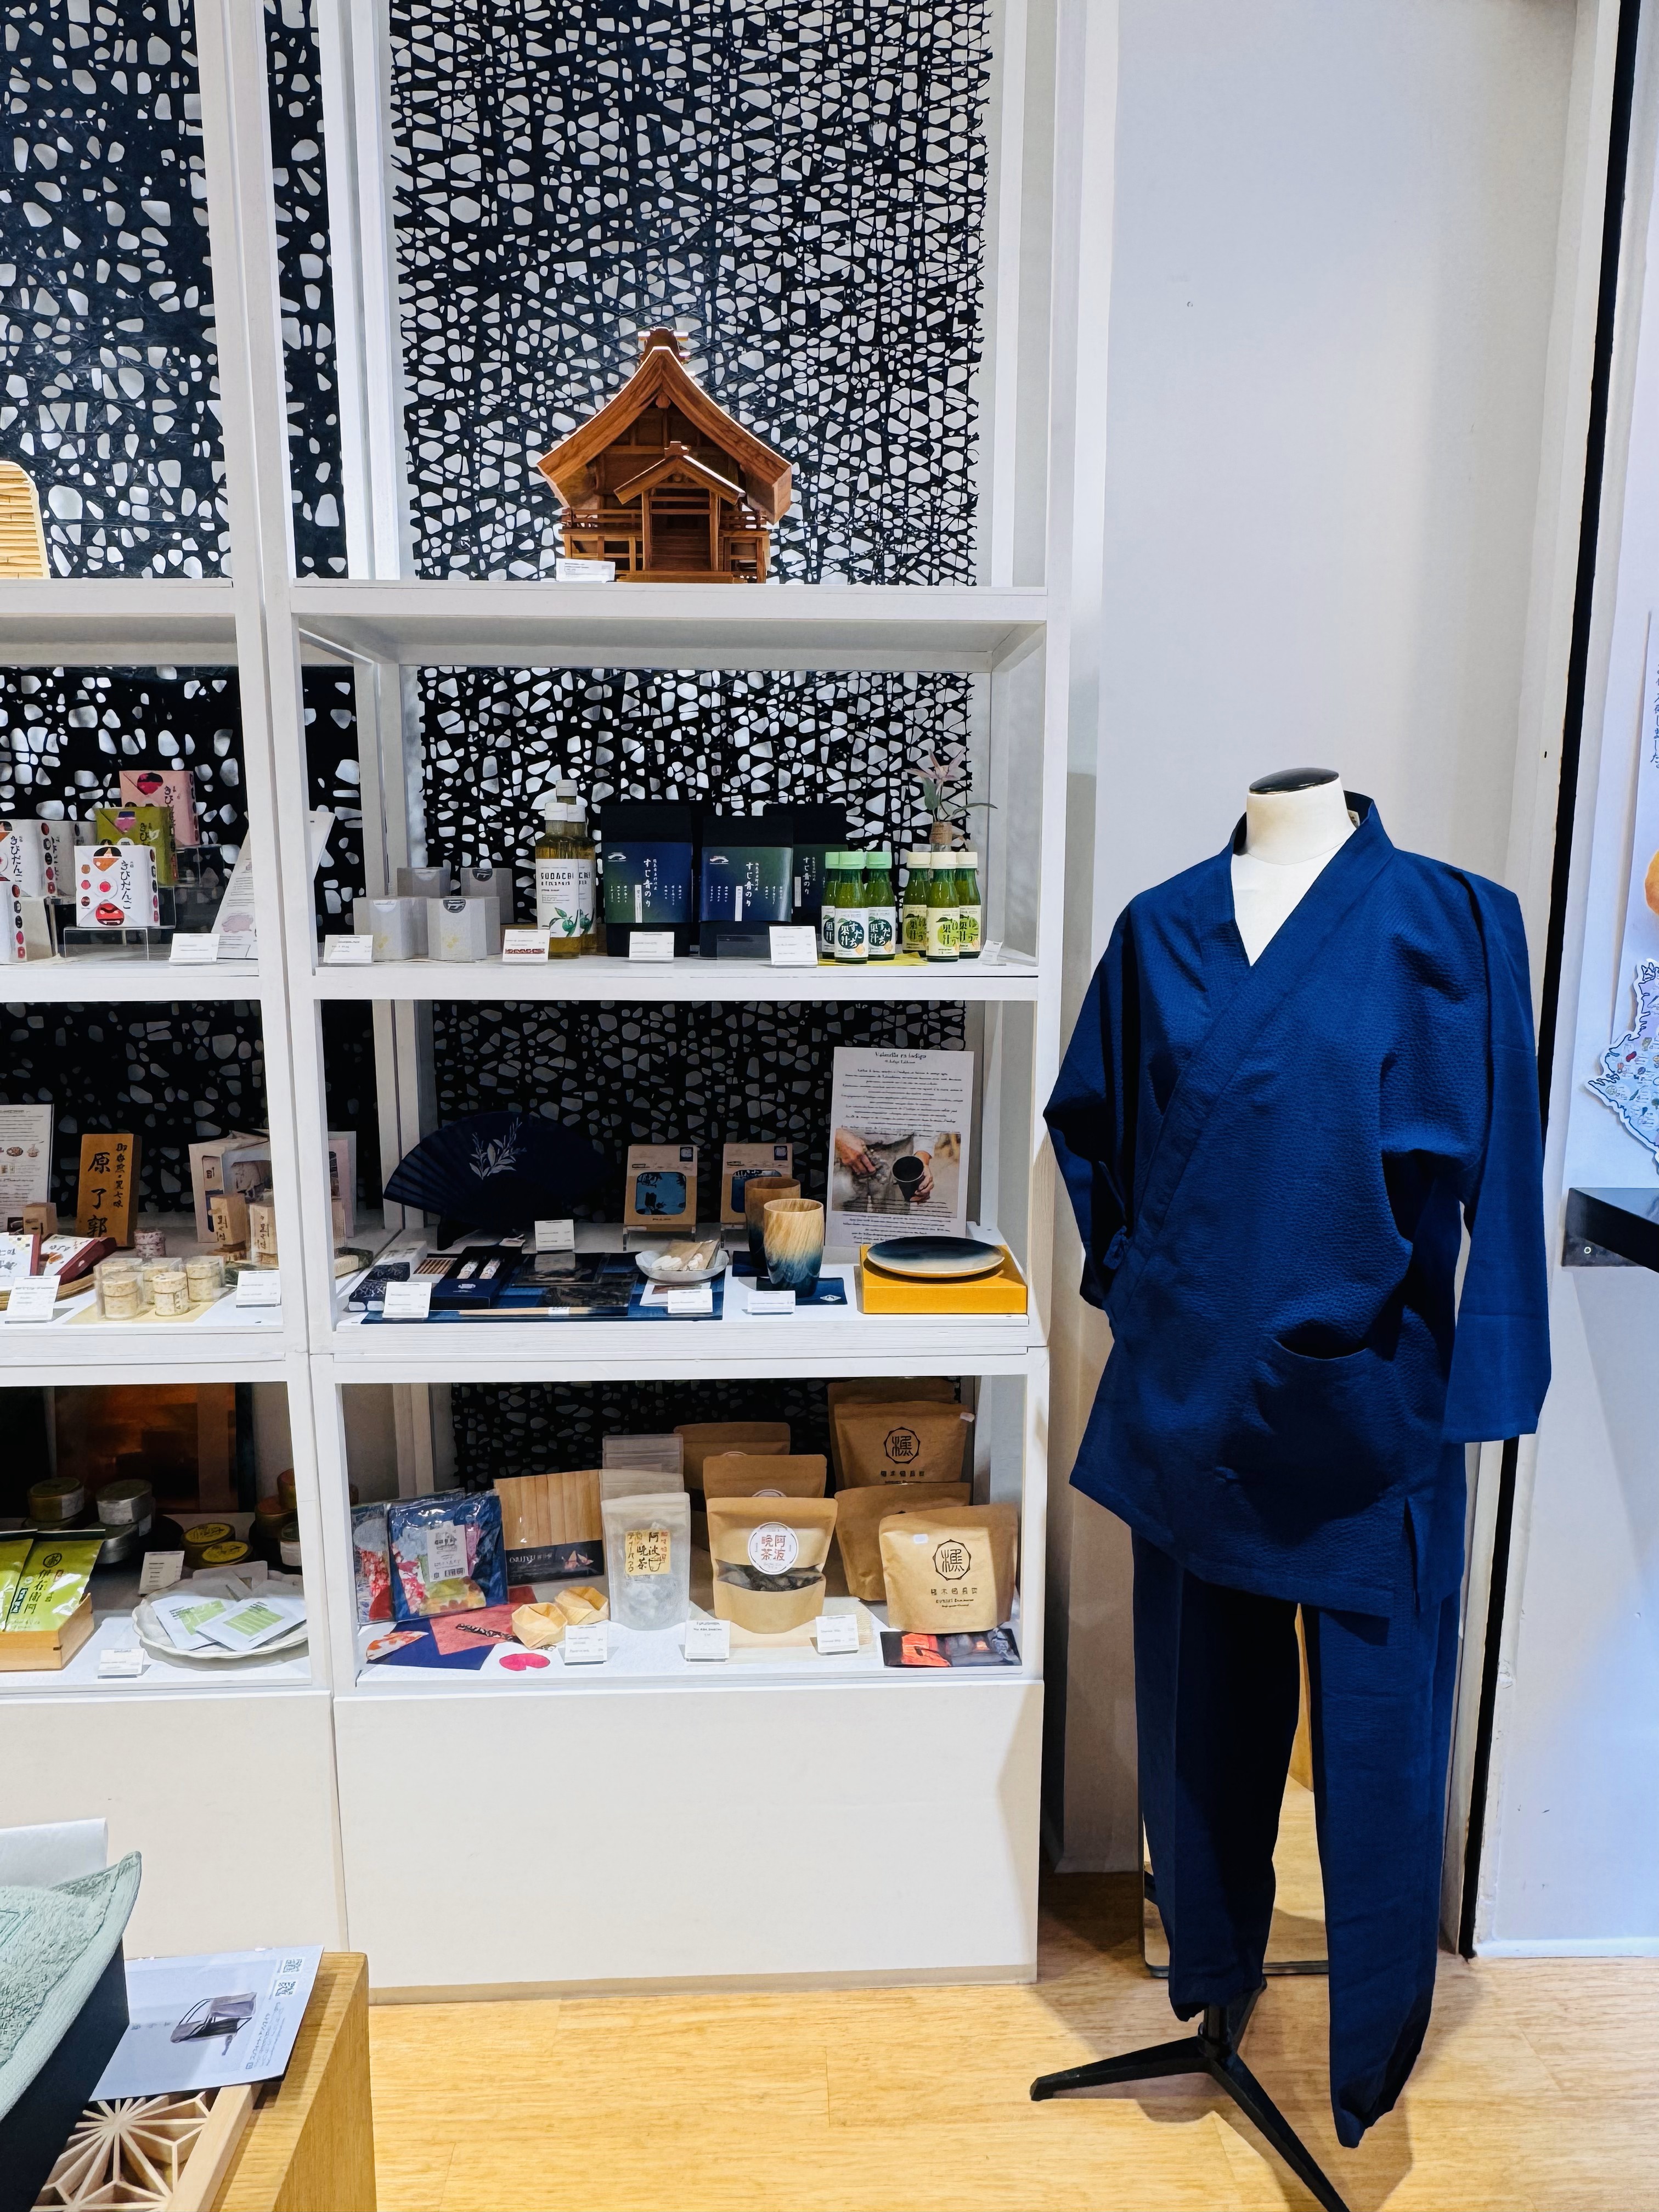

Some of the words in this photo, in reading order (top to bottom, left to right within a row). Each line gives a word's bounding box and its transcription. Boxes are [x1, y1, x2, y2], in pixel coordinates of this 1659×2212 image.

[643, 859, 653, 907] すじ青のり
[744, 862, 755, 907] すじ青のり
[87, 1152, 111, 1238] 原了郭
